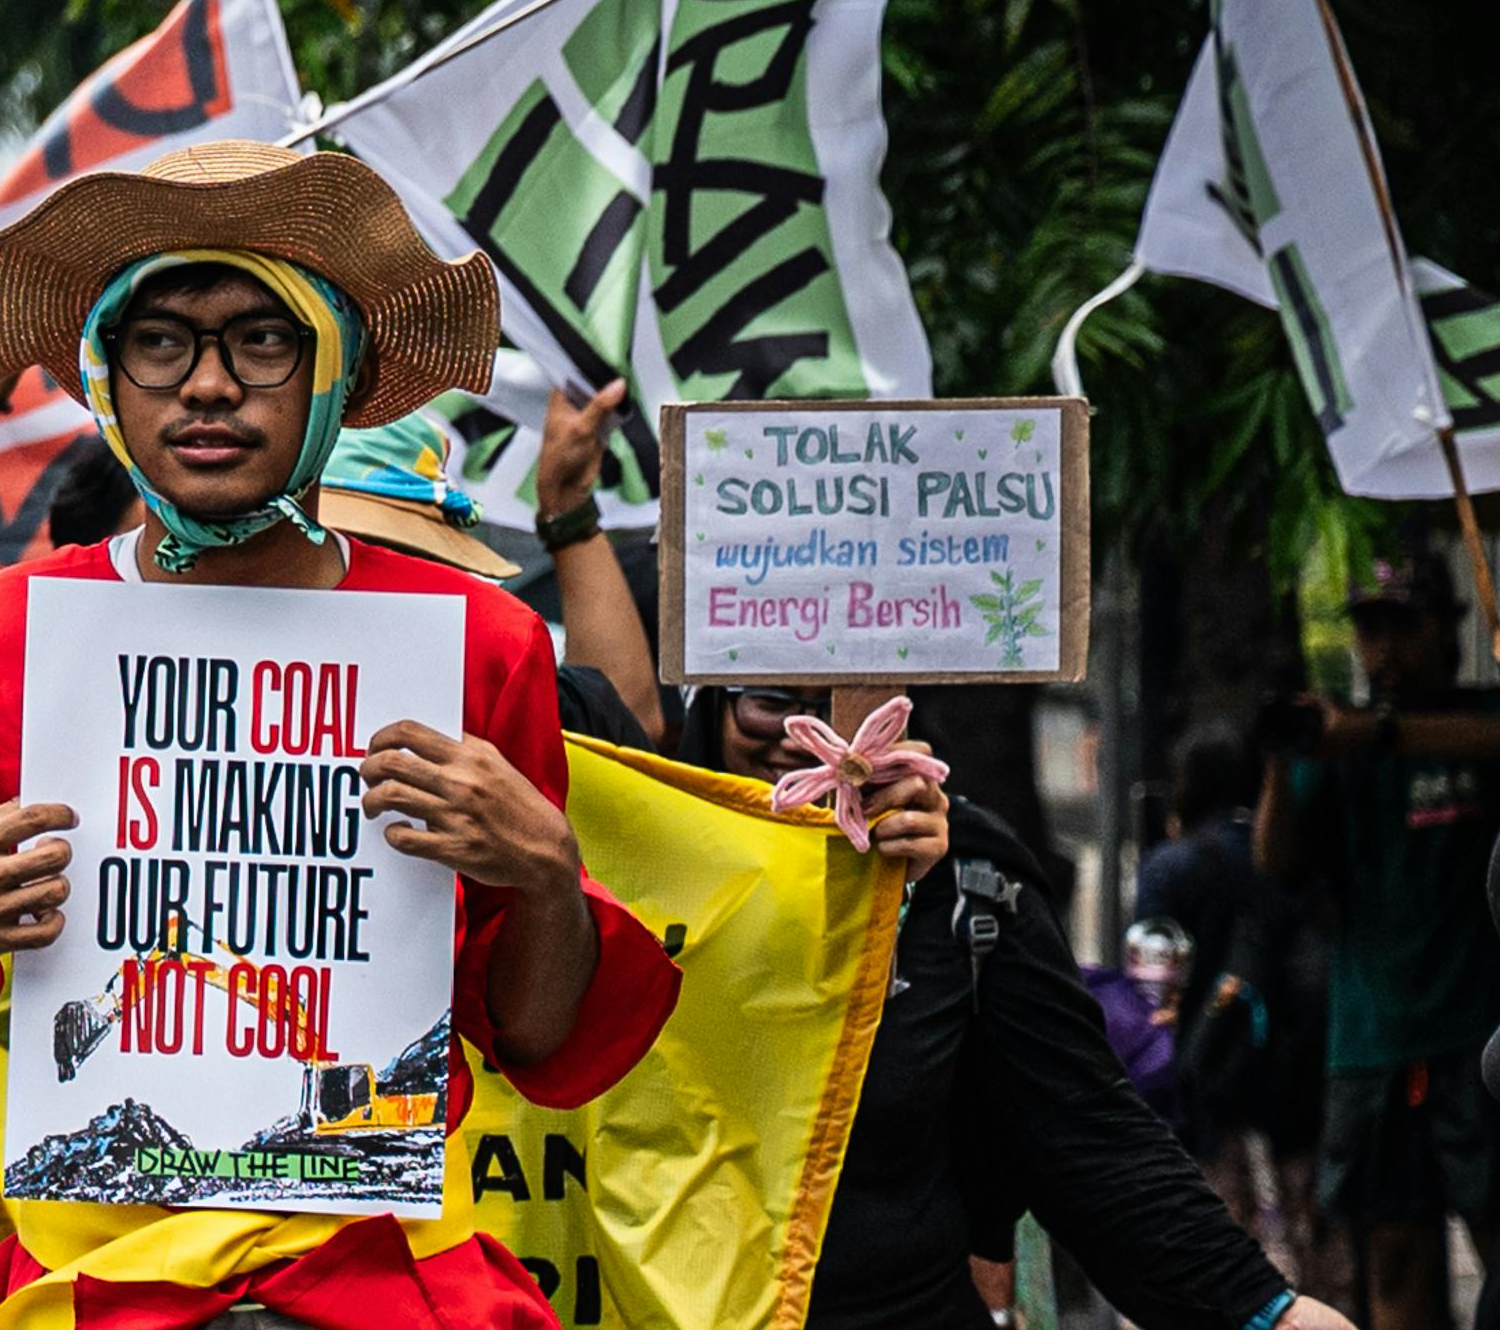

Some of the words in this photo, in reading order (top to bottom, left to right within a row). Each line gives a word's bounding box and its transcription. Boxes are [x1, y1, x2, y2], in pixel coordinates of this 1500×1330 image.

[763, 421, 920, 467] TOLAK
[716, 474, 890, 517] SOLUSI
[917, 471, 1056, 521] PALSU
[715, 527, 878, 585] wujudkan
[897, 529, 1010, 567] sistem
[708, 586, 830, 642] Energi
[847, 580, 962, 630] Bersih
[118, 654, 239, 752] YOUR
[250, 659, 367, 758] COAL
[116, 756, 161, 850] IS
[172, 757, 360, 859] MAKING
[96, 856, 191, 952] OUR
[201, 861, 374, 962] FUTURE
[119, 959, 216, 1055] NOT
[225, 962, 339, 1062] COOL
[136, 1147, 221, 1177] DRAW
[229, 1152, 289, 1177] THE
[300, 1154, 360, 1180] LINE
